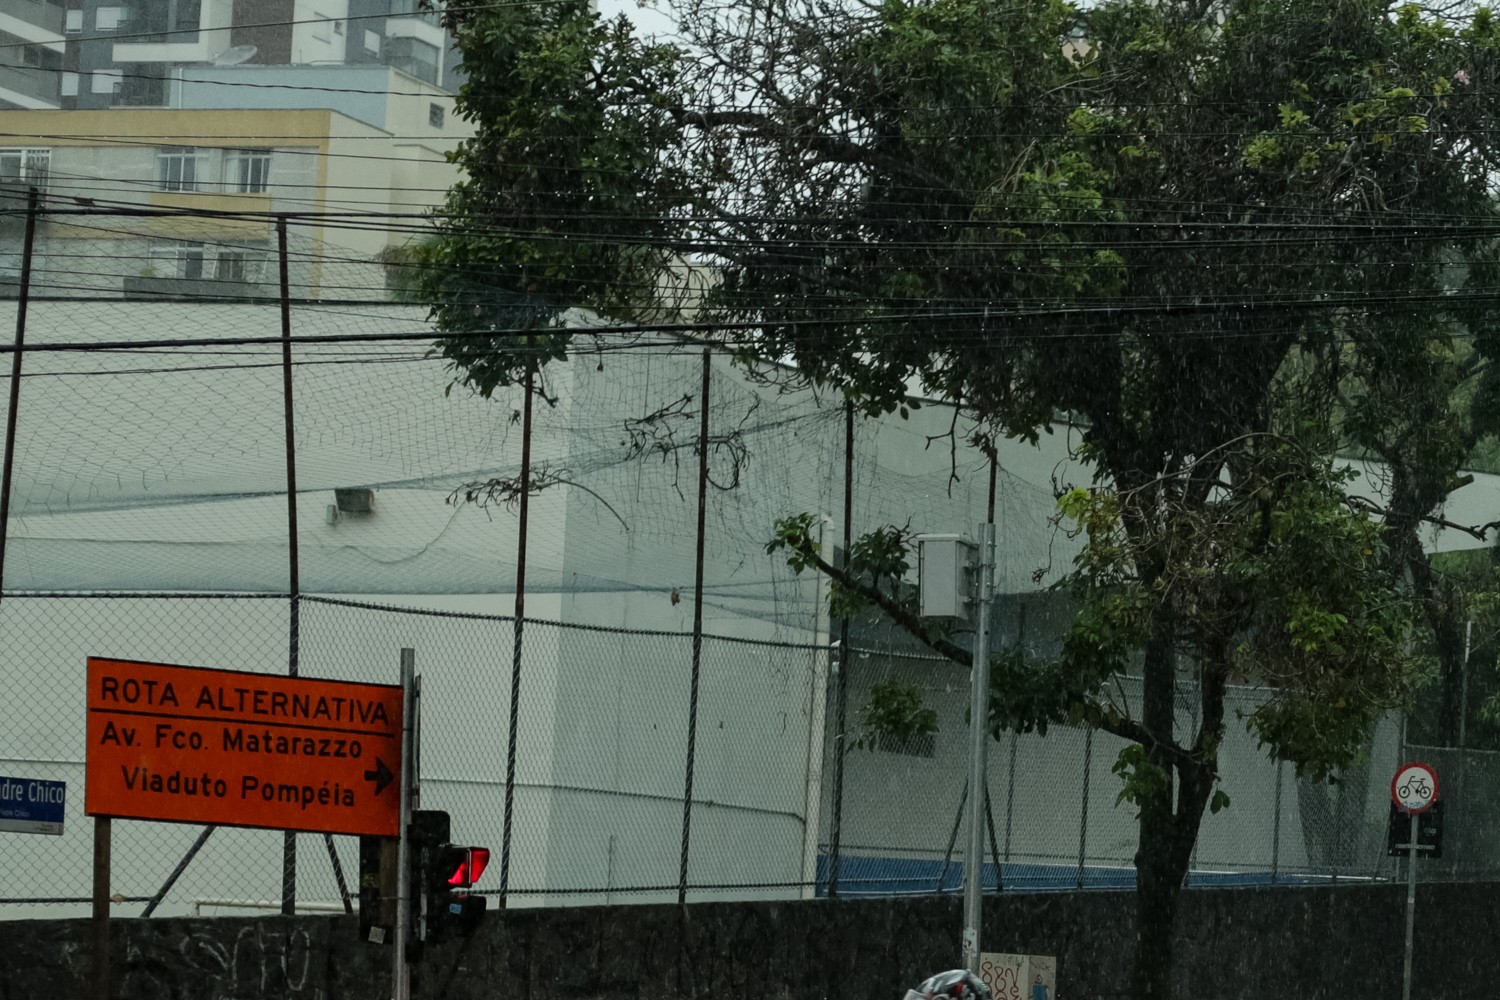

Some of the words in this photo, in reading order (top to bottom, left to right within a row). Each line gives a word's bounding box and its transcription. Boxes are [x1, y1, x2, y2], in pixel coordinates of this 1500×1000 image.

[101, 677, 179, 707] ROTA
[195, 686, 389, 726] ALTERNATIVA
[101, 721, 141, 747] Av.
[155, 724, 208, 750] Fco.
[223, 728, 362, 759] Matarazzo
[28, 781, 64, 804] Chico
[121, 765, 227, 798] Viaduto
[241, 776, 355, 810] Pompéia
